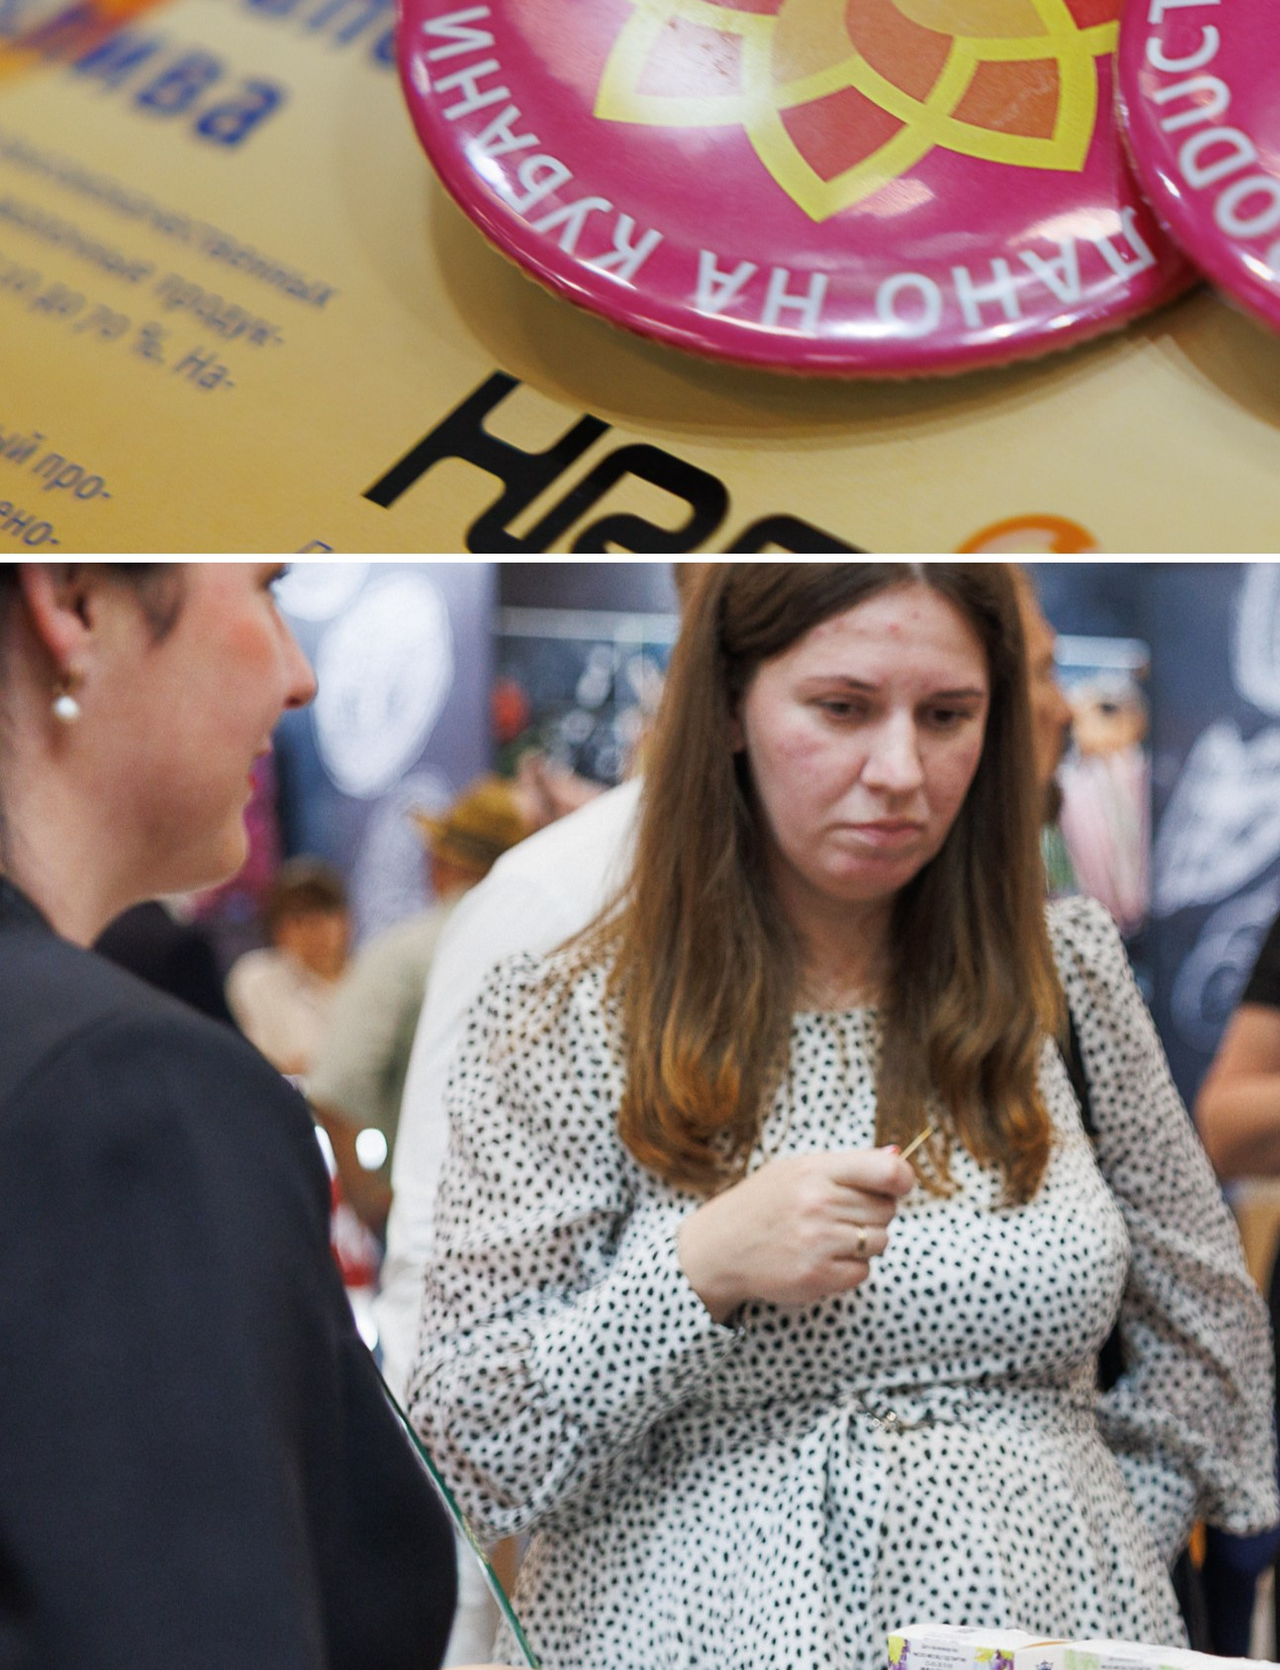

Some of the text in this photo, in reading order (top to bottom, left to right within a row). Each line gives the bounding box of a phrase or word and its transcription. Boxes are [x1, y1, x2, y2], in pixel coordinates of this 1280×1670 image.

[423, 5, 664, 282] КУБАНИ
[694, 250, 831, 328] НА
[876, 206, 1158, 337] ЛАНО
